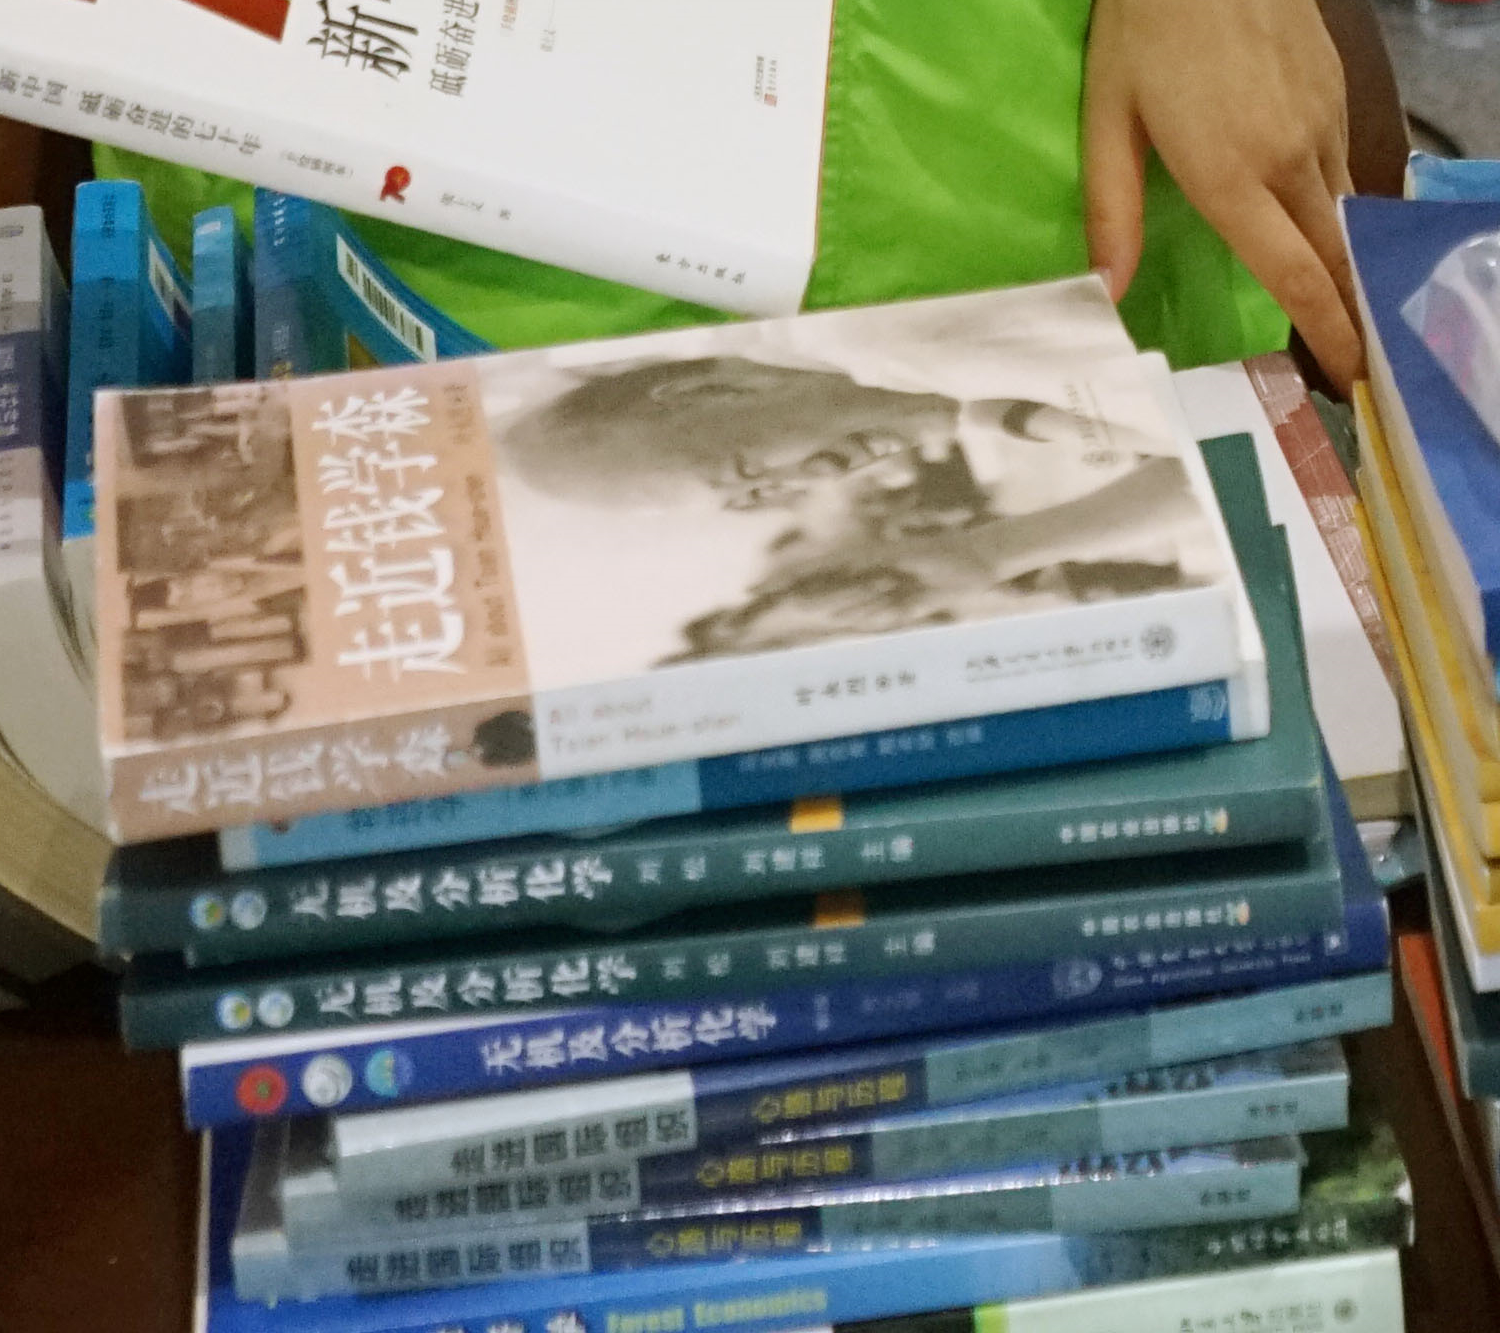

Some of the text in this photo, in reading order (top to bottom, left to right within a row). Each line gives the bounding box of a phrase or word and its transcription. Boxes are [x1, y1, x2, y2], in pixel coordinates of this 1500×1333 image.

[309, 385, 470, 685] 走近钱学森
[291, 856, 614, 920] 无机及分析化学
[315, 953, 638, 1018] 无机及分析化学
[482, 1001, 778, 1076] 无机及分析化学
